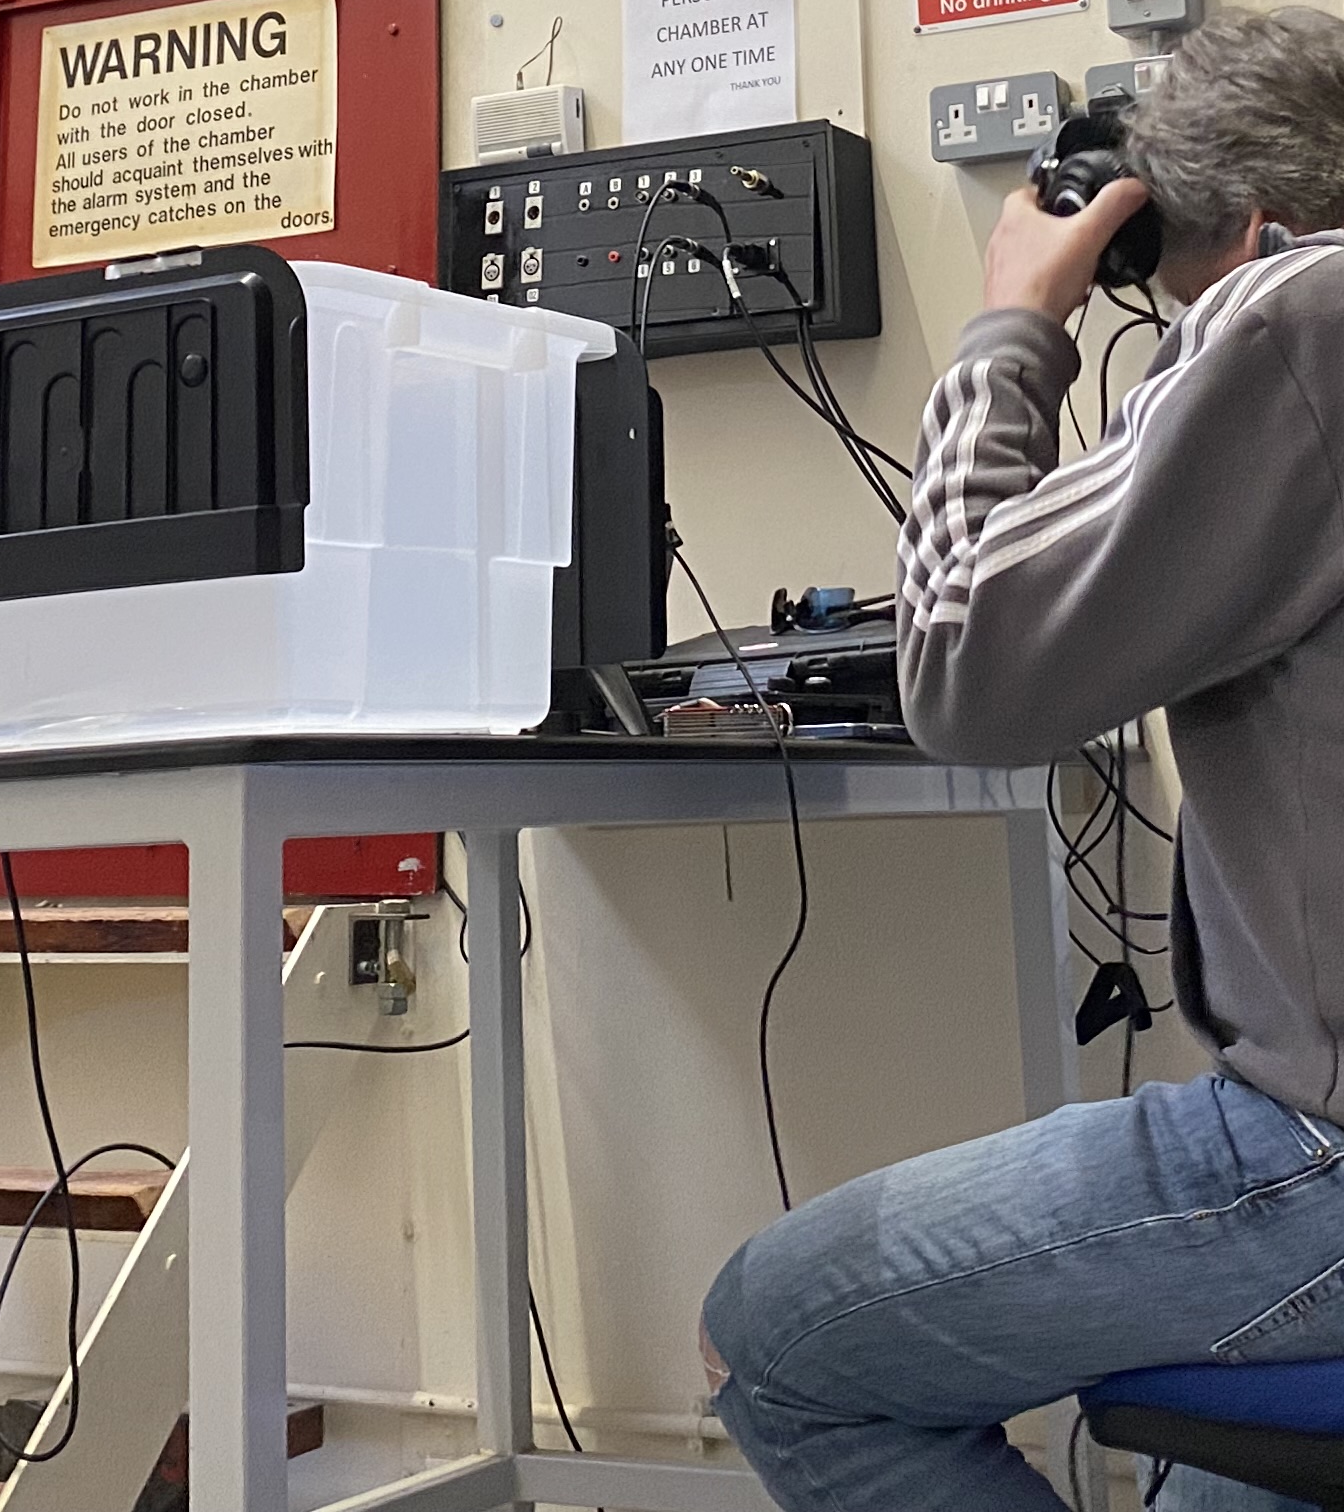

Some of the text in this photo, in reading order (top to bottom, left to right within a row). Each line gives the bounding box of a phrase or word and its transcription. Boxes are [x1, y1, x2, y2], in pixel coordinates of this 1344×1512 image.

[59, 11, 286, 88] WARNING
[657, 12, 768, 43] CHAMBER AT
[651, 46, 775, 78] ANY ONE TIME
[730, 76, 781, 91] THANK YOU
[59, 68, 319, 120] Do not work in the chamber
[57, 102, 252, 145] with the door closed.
[52, 138, 333, 193] should acquaint themselves with
[56, 124, 275, 170] All users of the chamber
[52, 170, 271, 215] the alarm system and the
[49, 193, 282, 238] emergency catches on the
[281, 208, 333, 229] doors.
